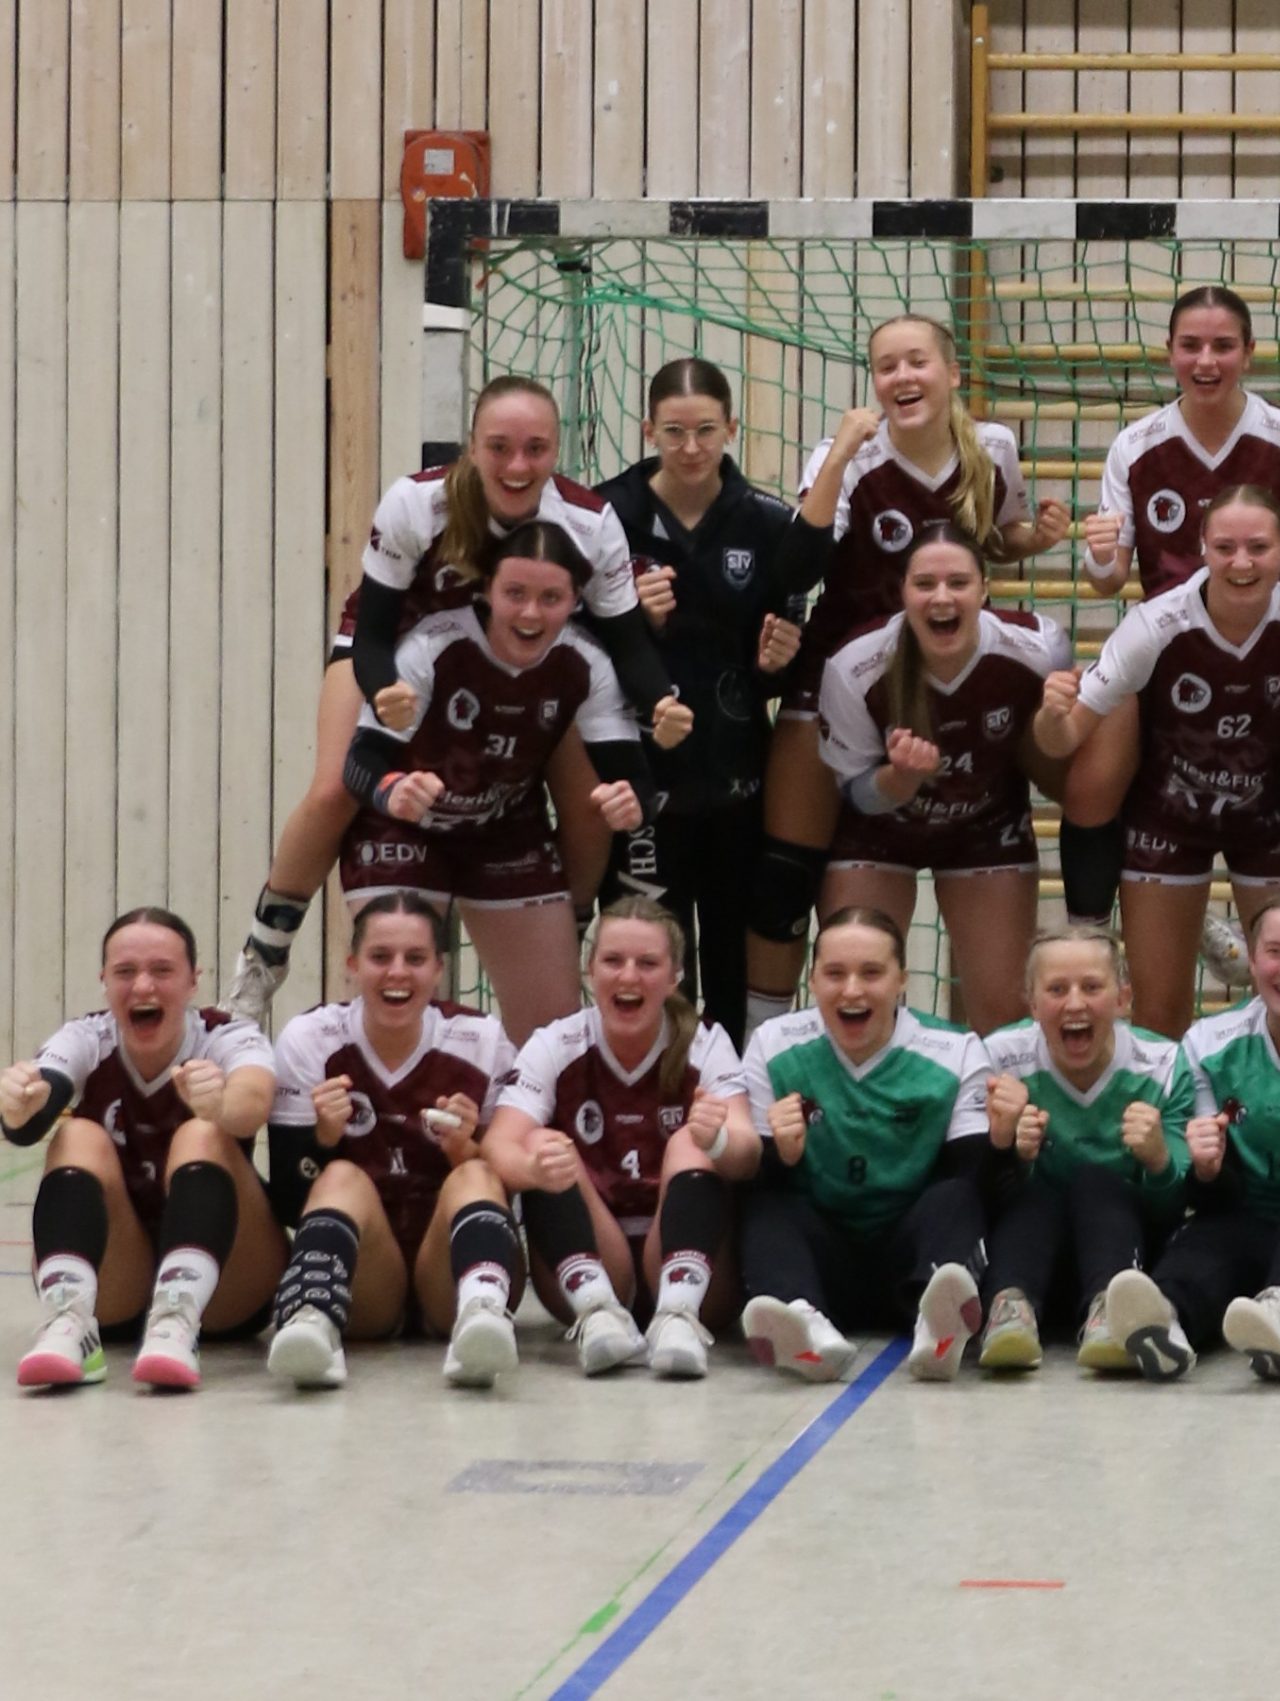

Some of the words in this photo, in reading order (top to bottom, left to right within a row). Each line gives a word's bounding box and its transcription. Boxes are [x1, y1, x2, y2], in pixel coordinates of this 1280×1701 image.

[1216, 713, 1252, 740] 62
[484, 733, 518, 759] 31
[940, 751, 974, 777] 24
[380, 842, 428, 864] EDV
[621, 1148, 642, 1181] 4
[848, 1154, 868, 1185] 8
